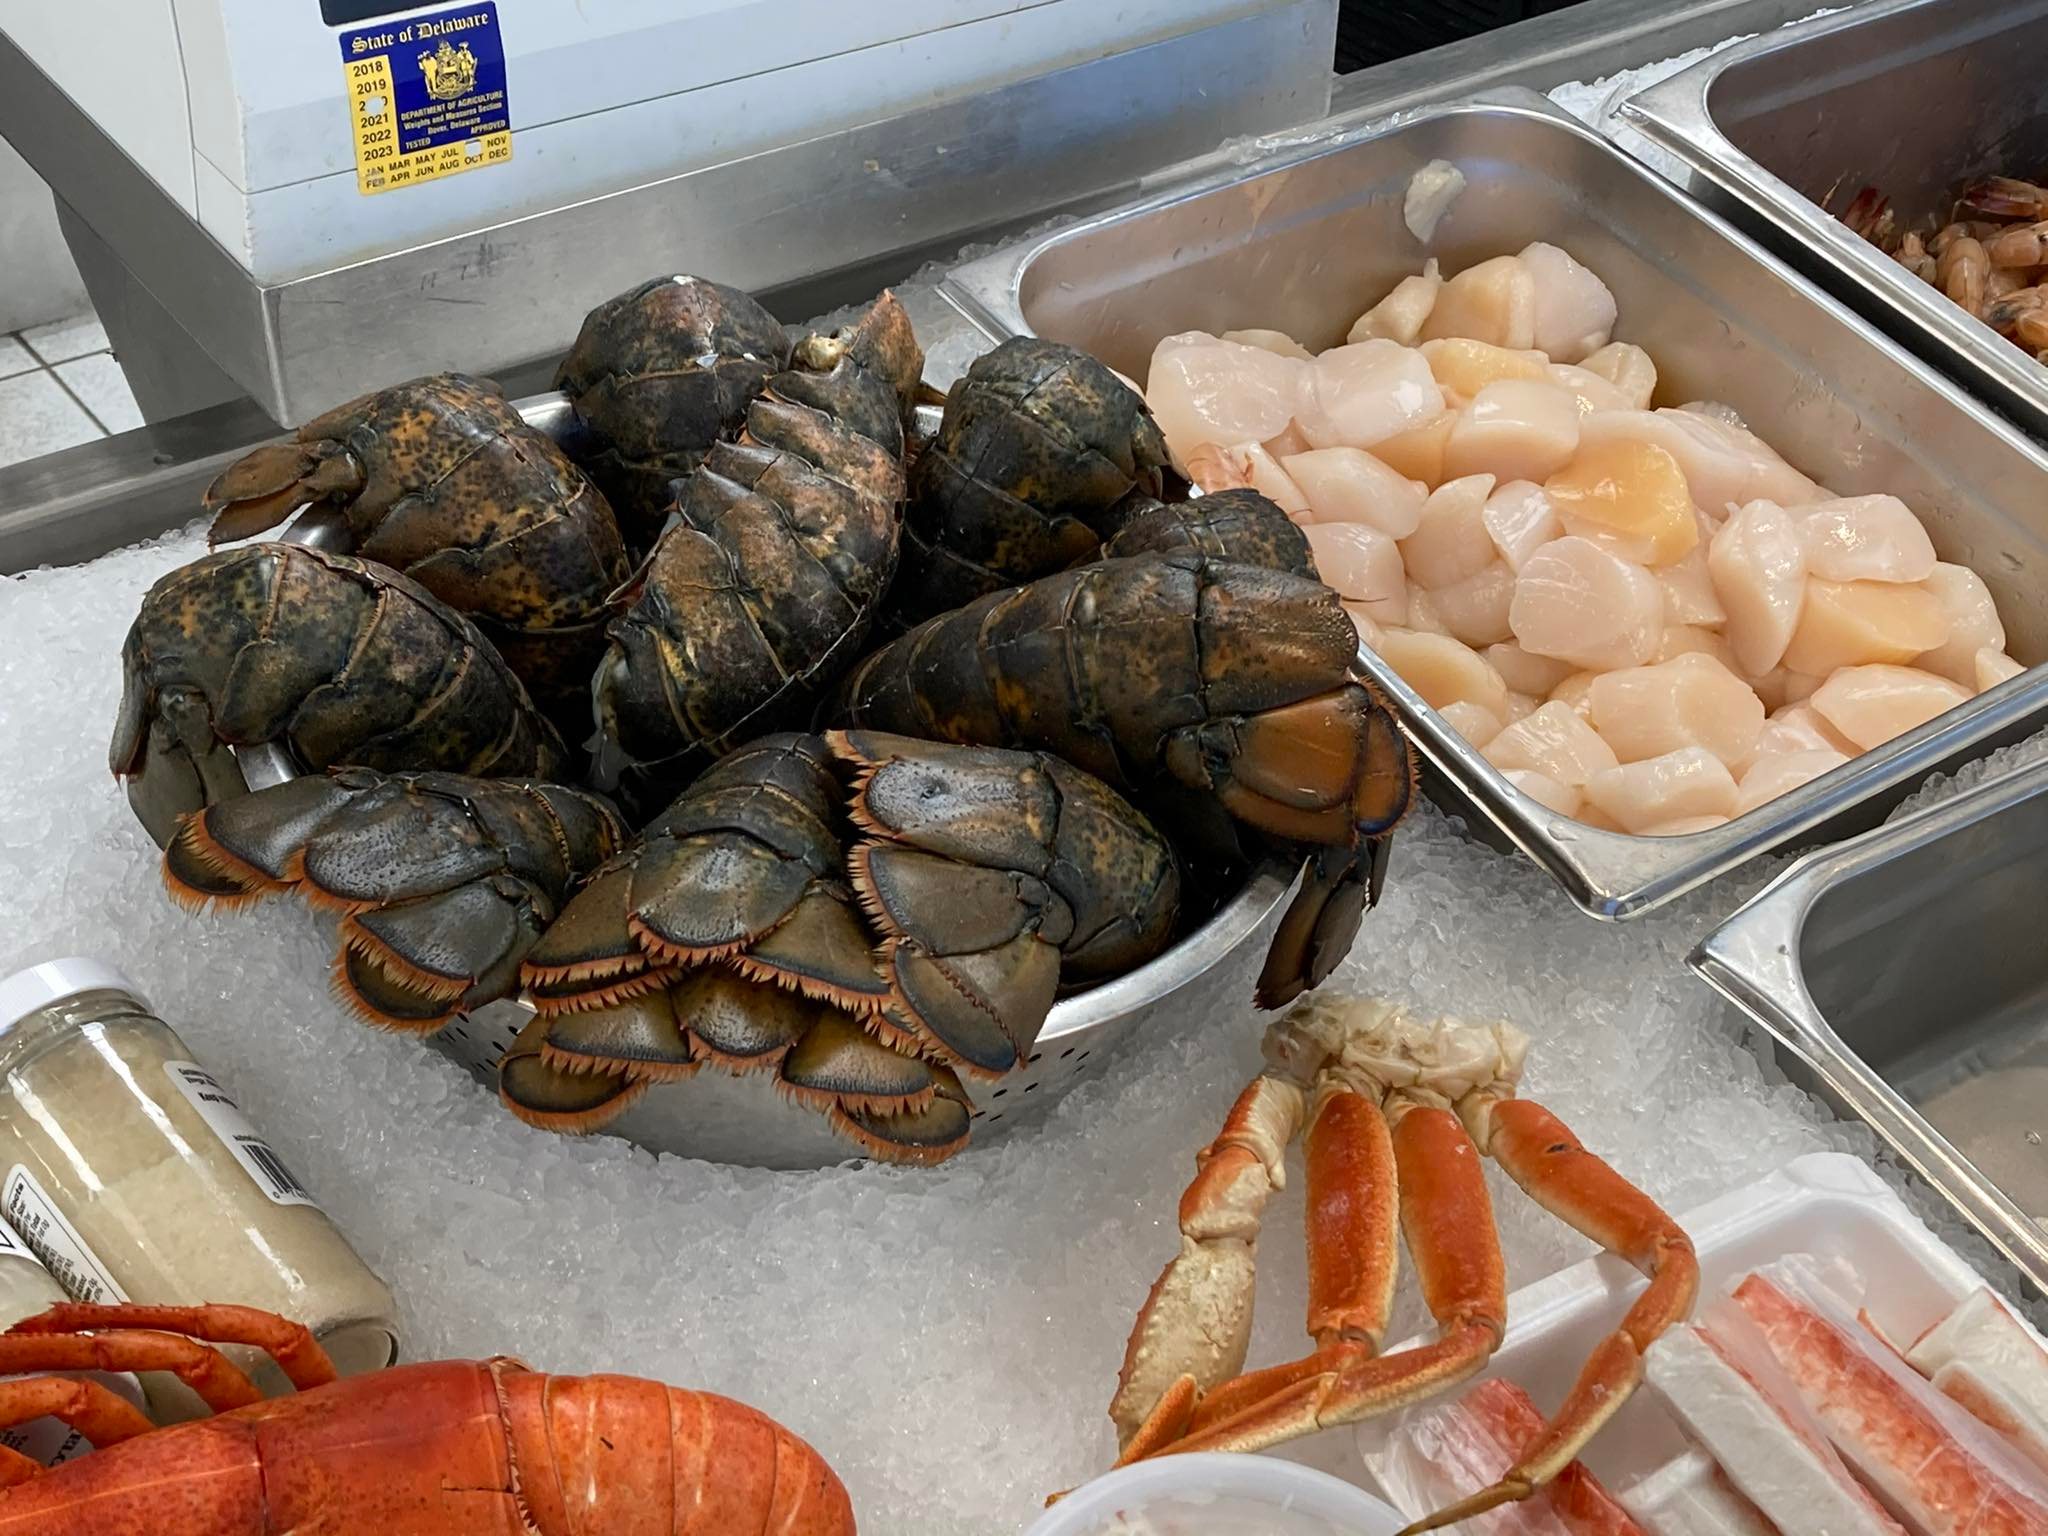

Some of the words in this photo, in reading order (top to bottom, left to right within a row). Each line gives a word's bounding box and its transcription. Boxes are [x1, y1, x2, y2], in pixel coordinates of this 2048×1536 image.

[352, 33, 394, 54] State
[399, 27, 413, 43] of
[416, 13, 488, 39] Delaware
[353, 62, 383, 77] 2018
[356, 79, 386, 94] 2019
[401, 106, 446, 121] DEPARTMENT
[447, 101, 457, 110] OF
[458, 90, 504, 107] AGRICULTURE
[360, 113, 388, 128] 2021
[404, 118, 430, 130] Weights
[432, 114, 444, 124] and
[446, 108, 478, 120] Measures
[478, 102, 502, 113] Section
[450, 117, 480, 130] Delaware
[471, 120, 506, 134] APPROVED
[362, 130, 391, 145] 2022
[406, 138, 430, 150] TESTED
[364, 146, 393, 161] 2023
[390, 160, 410, 171] MAR
[416, 153, 436, 165] MAY
[442, 148, 459, 158] JUL
[488, 136, 507, 148] NOV
[366, 178, 385, 188] FEB
[391, 172, 410, 183] APR
[415, 166, 434, 177] JUN
[440, 160, 460, 172] AUG
[465, 154, 484, 165] OCT
[489, 148, 508, 159] DEC
[10, 1183, 24, 1213] Facts
